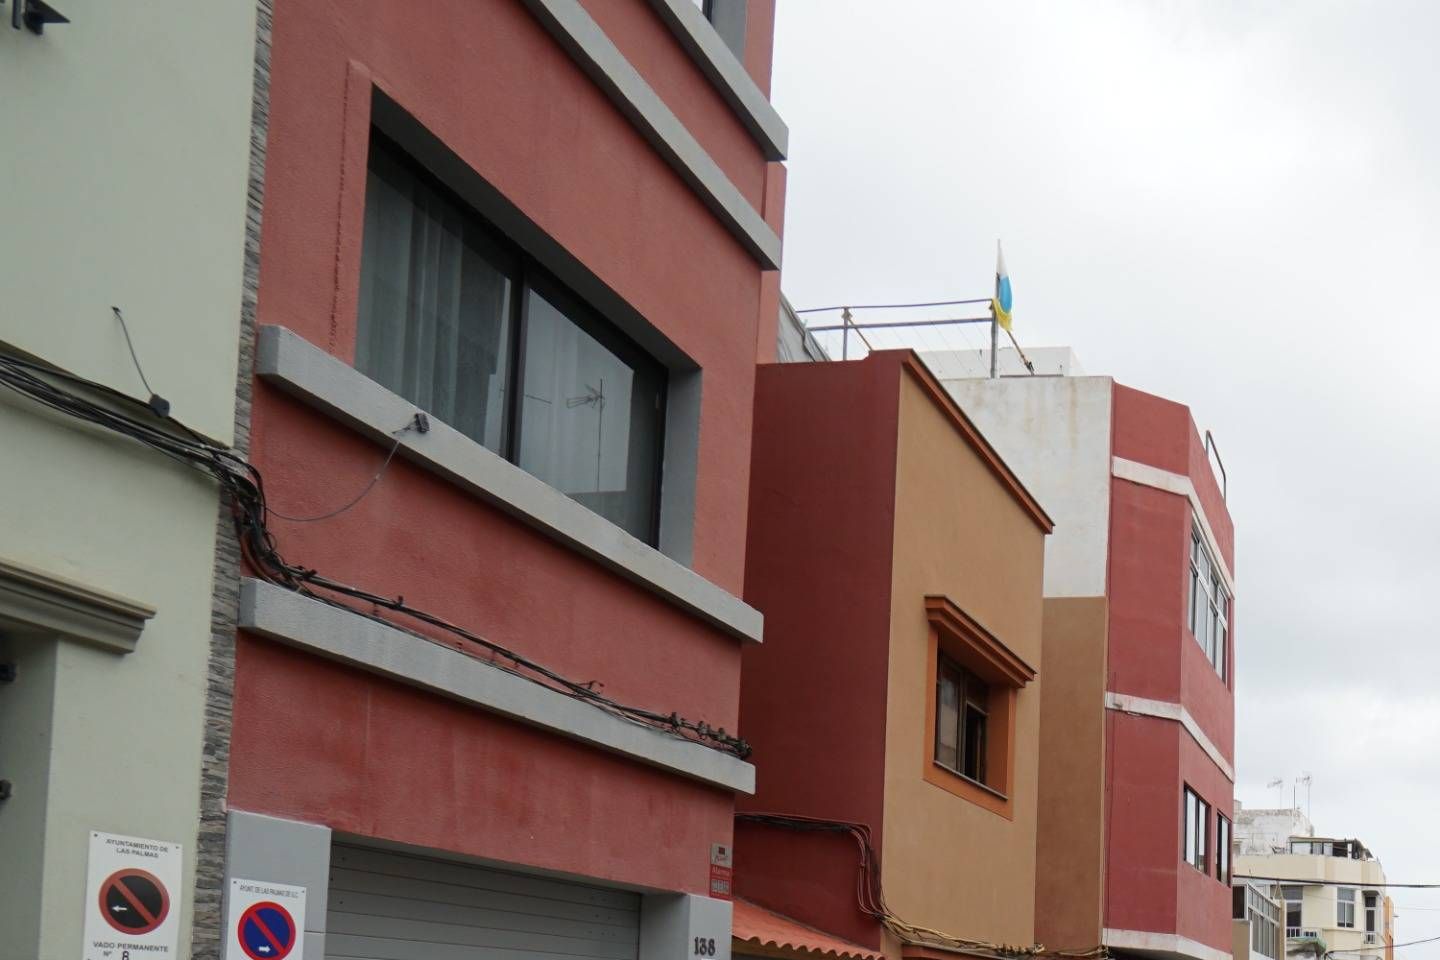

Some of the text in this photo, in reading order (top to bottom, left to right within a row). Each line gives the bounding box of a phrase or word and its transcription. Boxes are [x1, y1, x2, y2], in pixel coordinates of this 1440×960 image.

[105, 838, 169, 853] AYUNTAMIENTO DE
[116, 848, 159, 859] LAS PALMAS
[93, 941, 169, 953] VADO PERMANENTE
[694, 936, 716, 956] 138
